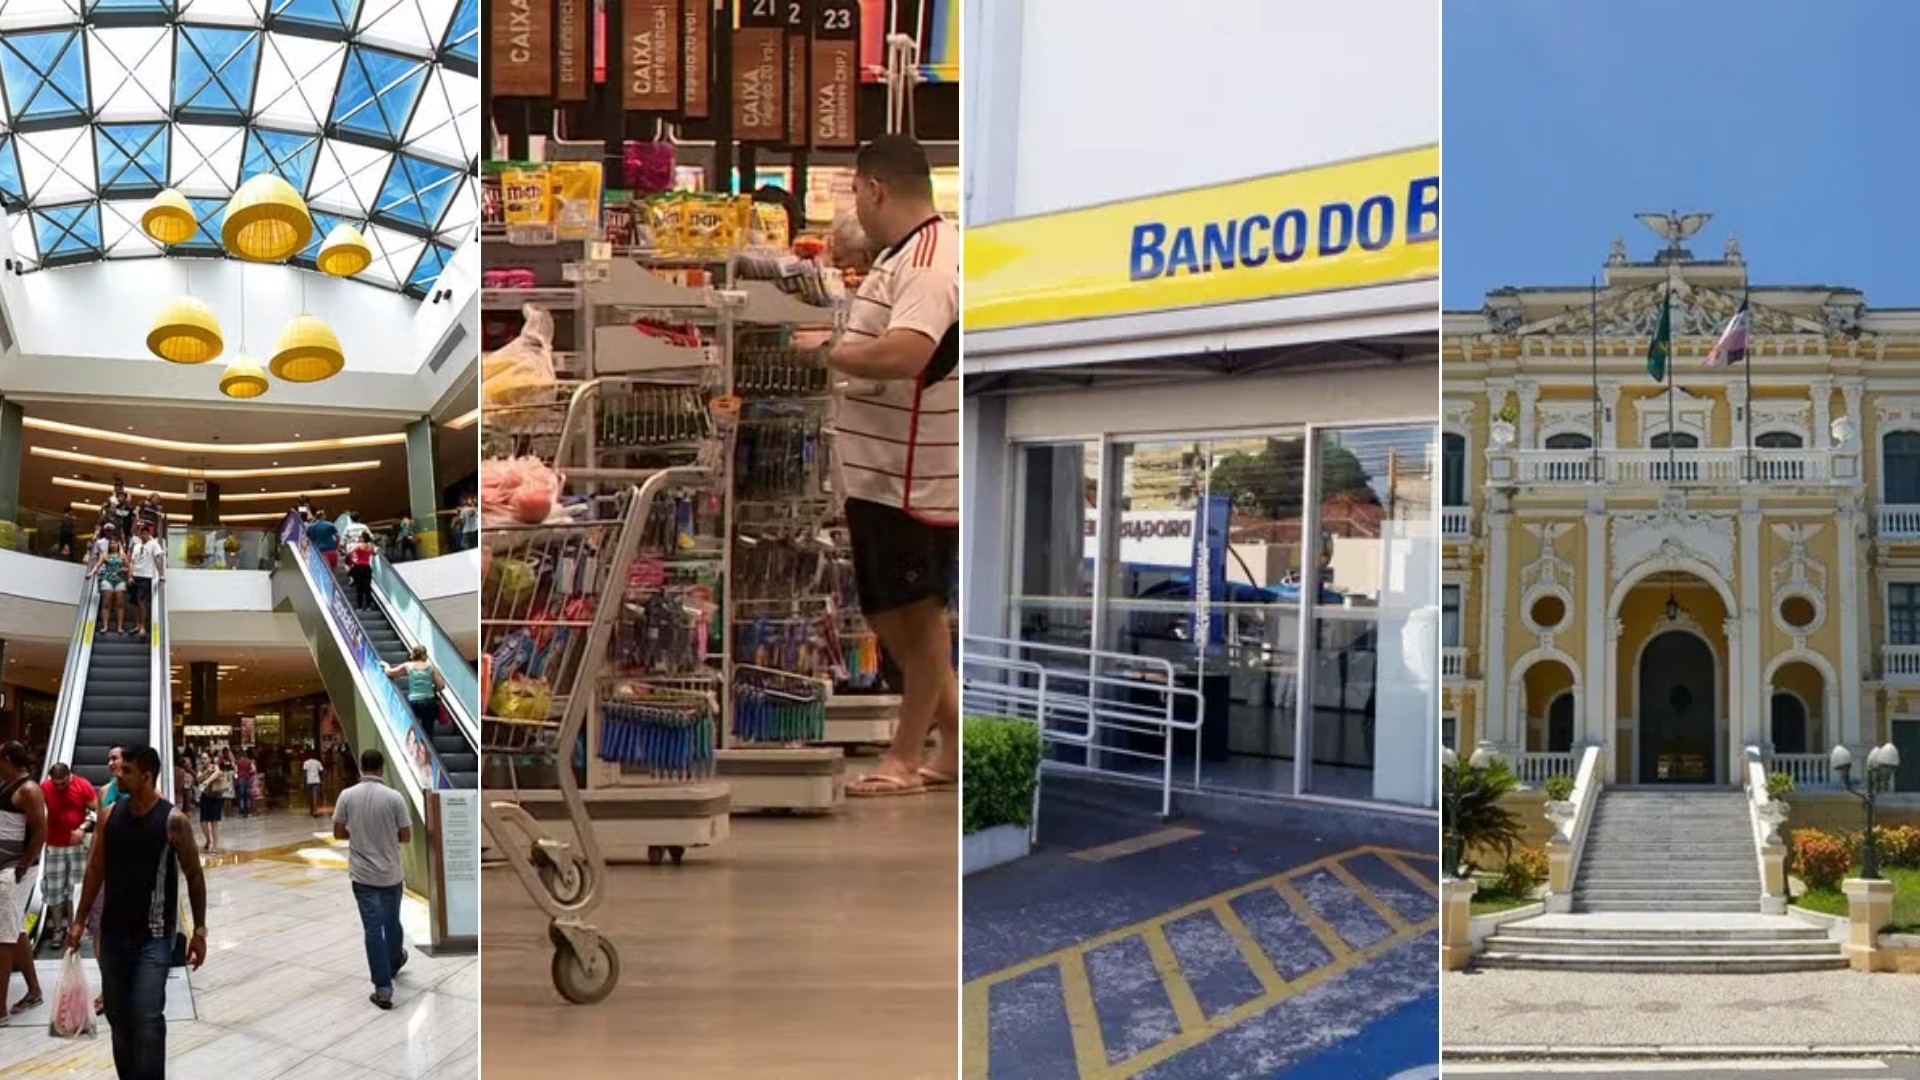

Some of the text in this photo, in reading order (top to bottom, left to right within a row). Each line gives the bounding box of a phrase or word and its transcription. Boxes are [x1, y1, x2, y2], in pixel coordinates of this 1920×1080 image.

[510, 0, 530, 63] CAIXA
[753, 0, 775, 16] 21
[824, 8, 851, 30] 23
[632, 31, 652, 94] CAIXA
[651, 5, 672, 93] preferencial
[760, 65, 773, 80] 20
[835, 50, 848, 82] CNPJ
[743, 69, 760, 126] CAIXA
[819, 84, 835, 138] CAIXA
[1130, 208, 1309, 281] BANCO
[1317, 195, 1395, 257] DO
